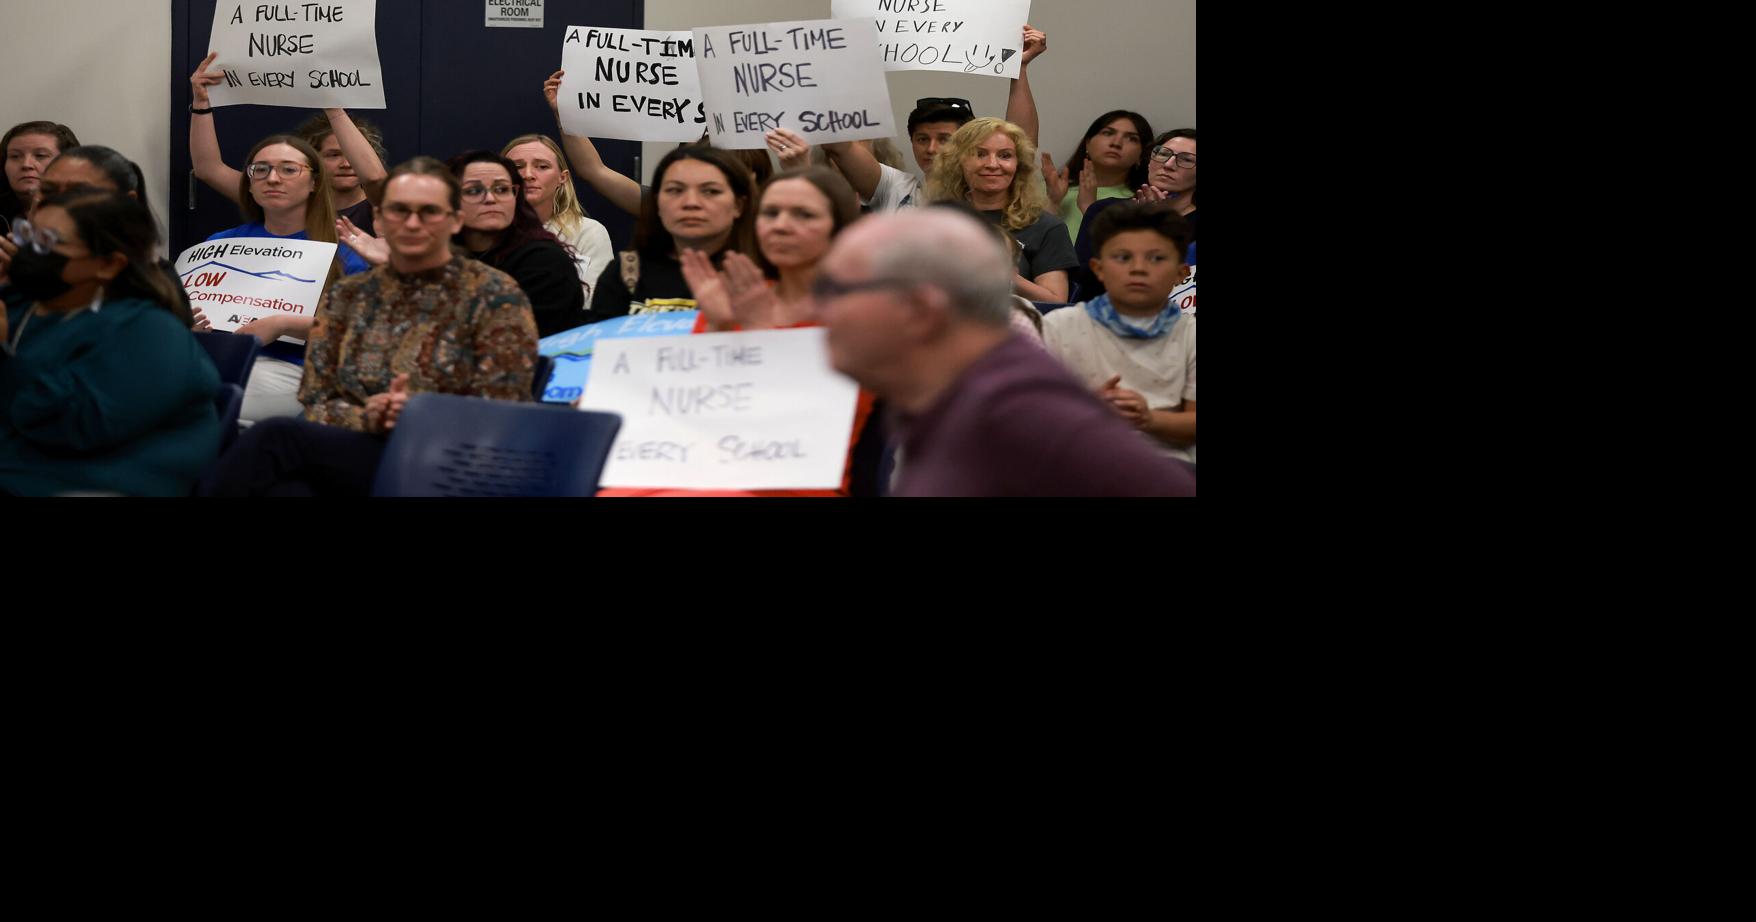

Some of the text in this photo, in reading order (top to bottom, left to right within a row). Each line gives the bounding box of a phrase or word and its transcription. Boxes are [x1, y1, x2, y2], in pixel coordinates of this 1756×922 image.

[231, 4, 343, 25] A FULL-TIME
[500, 7, 529, 16] ROOM
[878, 0, 946, 13] NURSE
[895, 20, 964, 33] EVERY
[248, 33, 314, 57] NURSE
[566, 29, 695, 58] A FULL-TIM
[704, 27, 847, 58] A FULL-TIME
[879, 43, 963, 64] HOOL
[223, 70, 371, 88] IN EVERY SCHOOL
[595, 56, 680, 86] NURSE
[734, 63, 817, 97] NURSE
[578, 92, 600, 110] IN
[612, 95, 691, 123] EVERY
[734, 111, 785, 133] EVERY
[798, 109, 880, 133] SCHOOL
[187, 243, 303, 263] HIGH Elevation
[184, 271, 304, 314] LOW Compensation
[612, 345, 763, 374] A FULL-TIME
[648, 382, 754, 416] NURSE
[616, 434, 807, 463] EVERY SCHOOL
